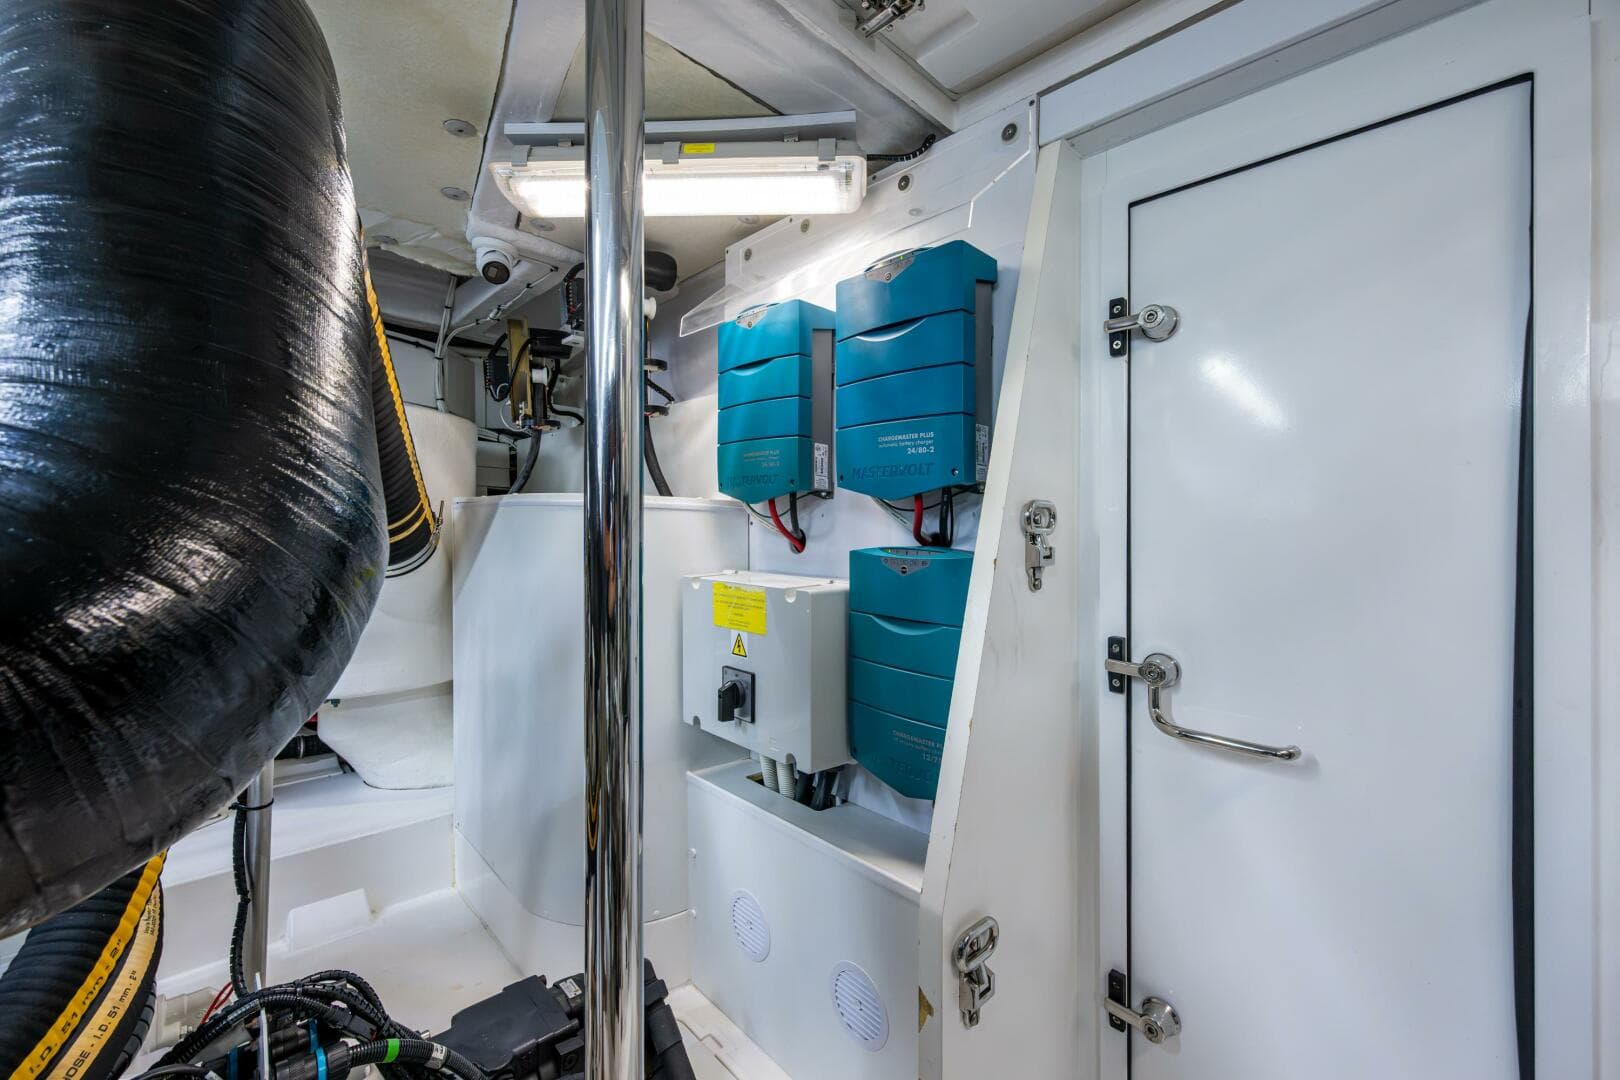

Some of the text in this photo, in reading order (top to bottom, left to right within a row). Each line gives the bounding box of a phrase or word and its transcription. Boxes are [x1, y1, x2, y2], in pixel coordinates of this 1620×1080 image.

[906, 446, 935, 455] 24/80-2
[919, 431, 935, 439] PLUS
[28, 1042, 58, 1074] I.D.
[61, 1011, 79, 1035] 51
[62, 1049, 91, 1080] OSE
[93, 1021, 112, 1040] I.D.
[107, 1006, 121, 1019] 51
[119, 987, 132, 1003] mm
